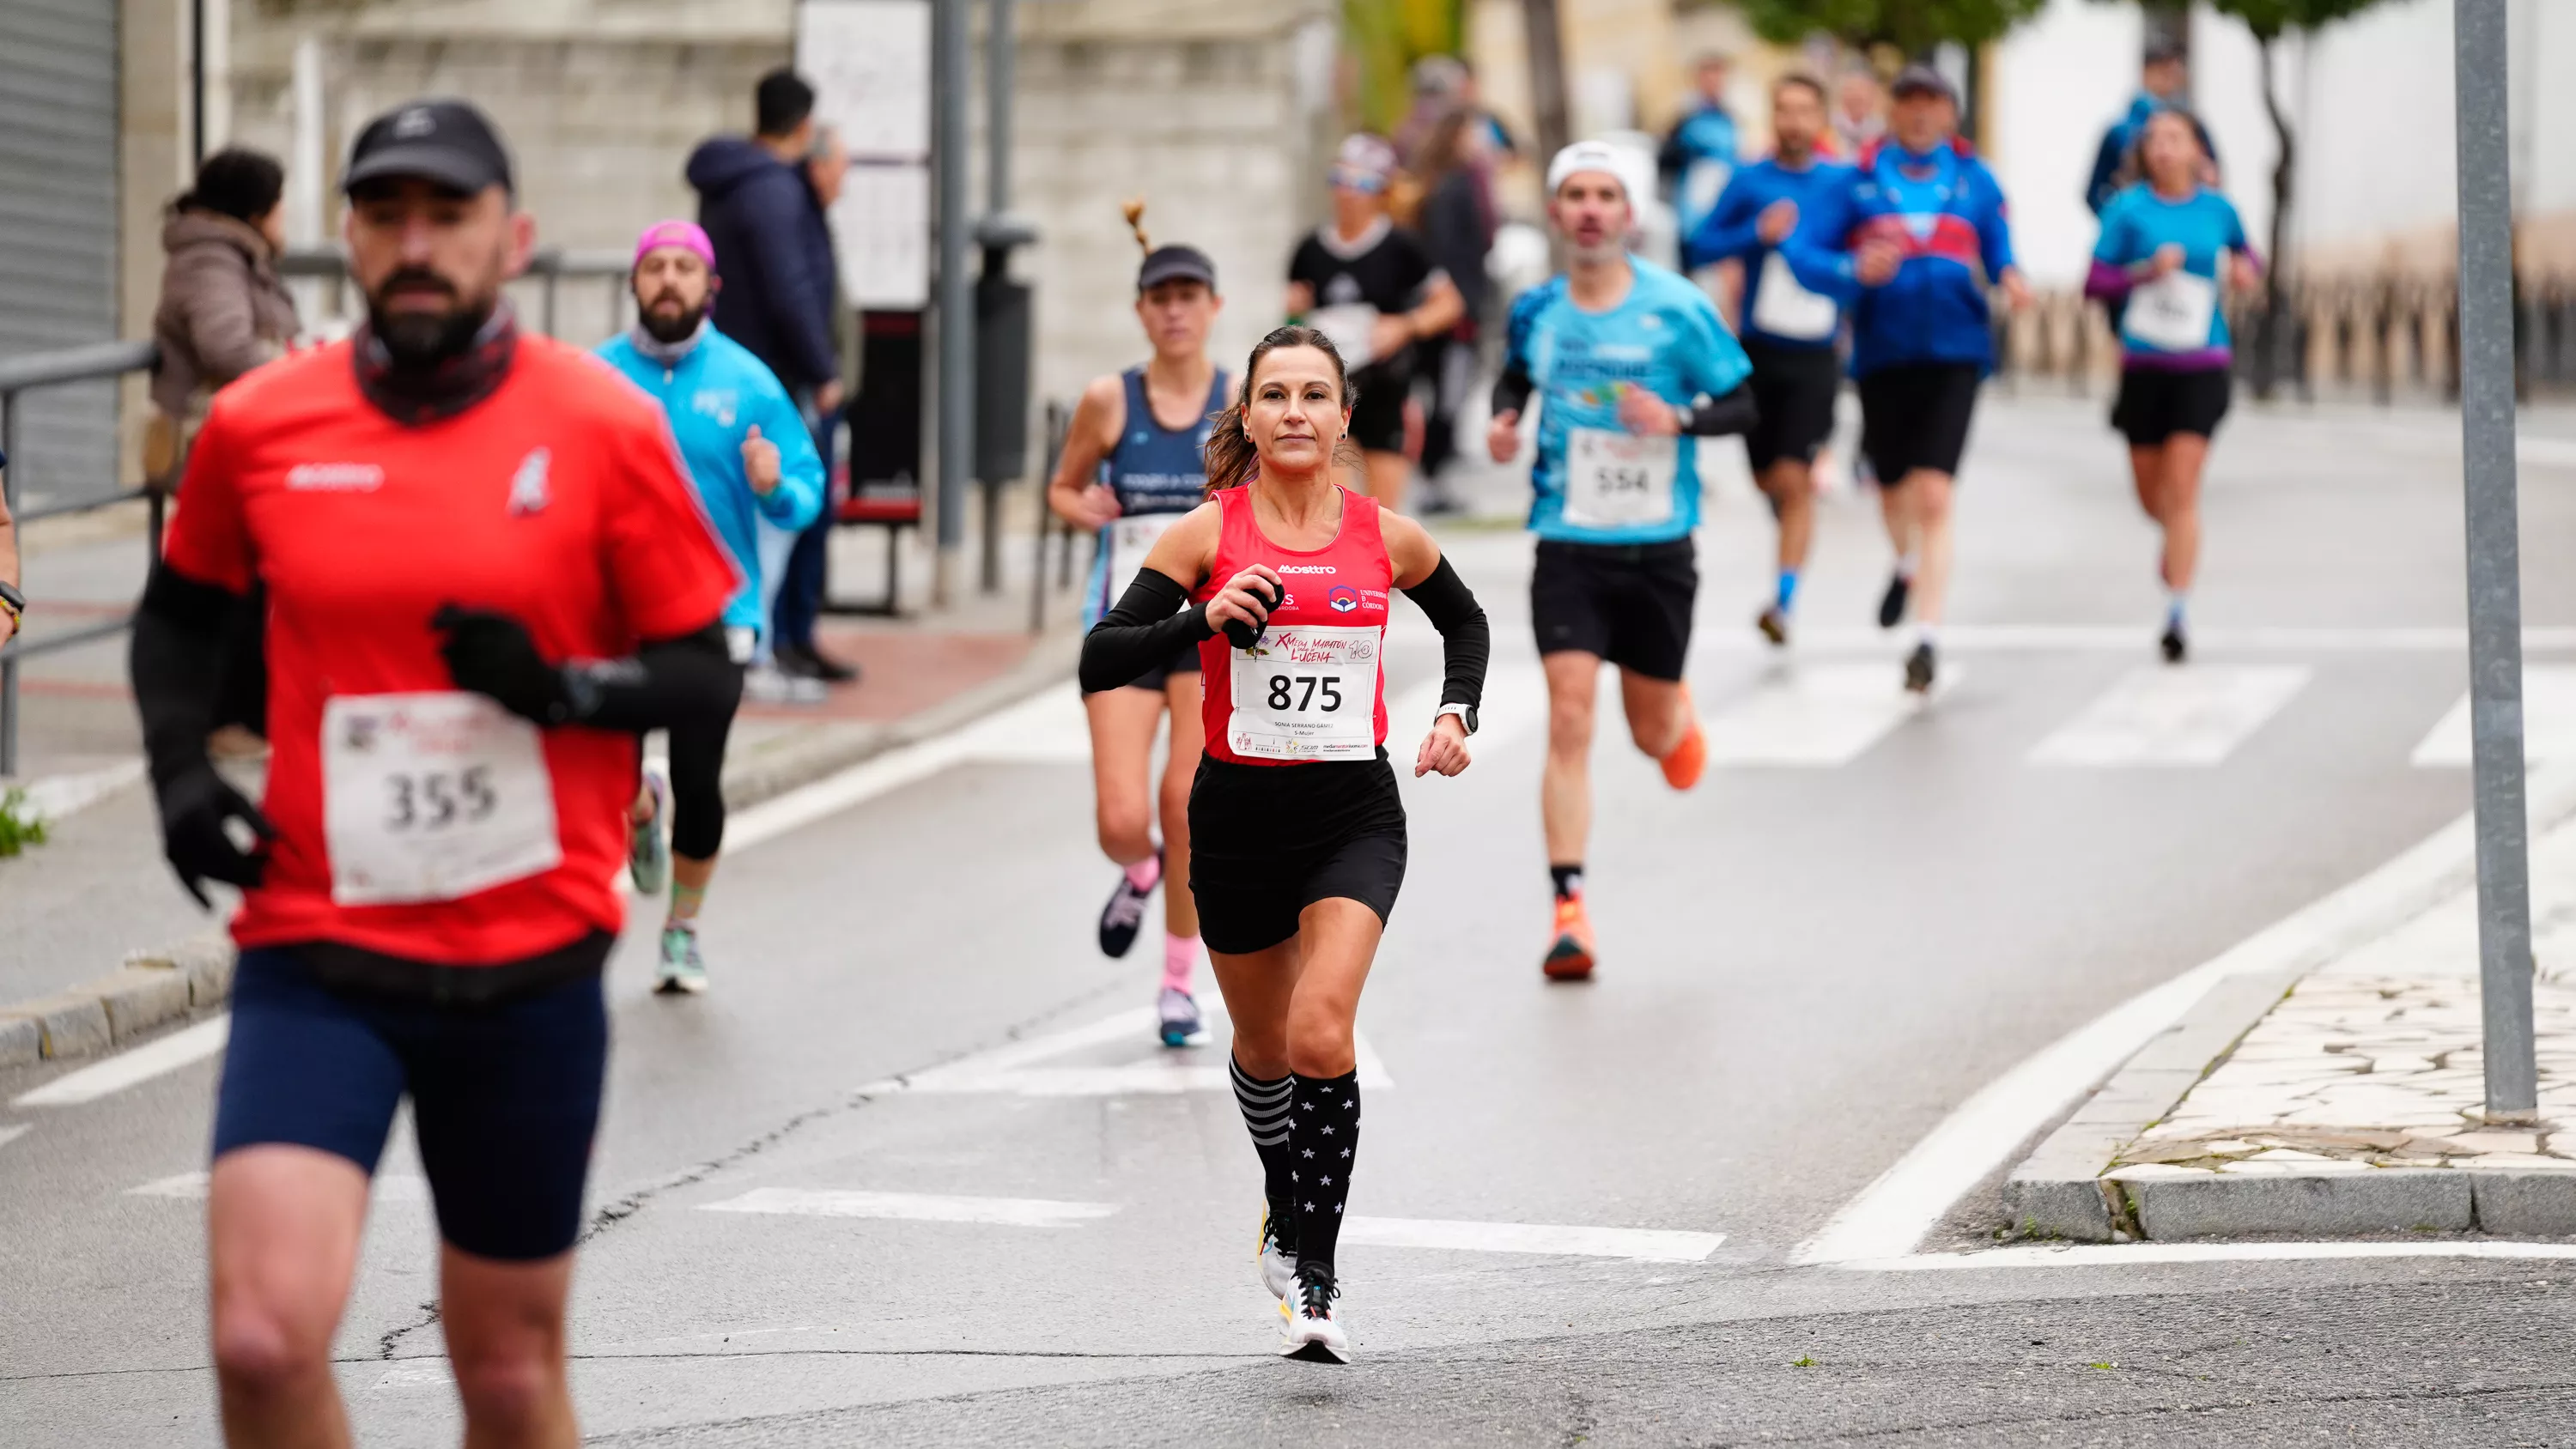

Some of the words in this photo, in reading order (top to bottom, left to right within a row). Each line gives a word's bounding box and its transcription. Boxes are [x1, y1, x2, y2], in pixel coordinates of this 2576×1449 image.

[1277, 564, 1337, 574] Mosttro
[1275, 632, 1291, 651] X
[1291, 648, 1336, 664] LUCENA
[1267, 675, 1342, 712] 875
[385, 765, 498, 831] 355
